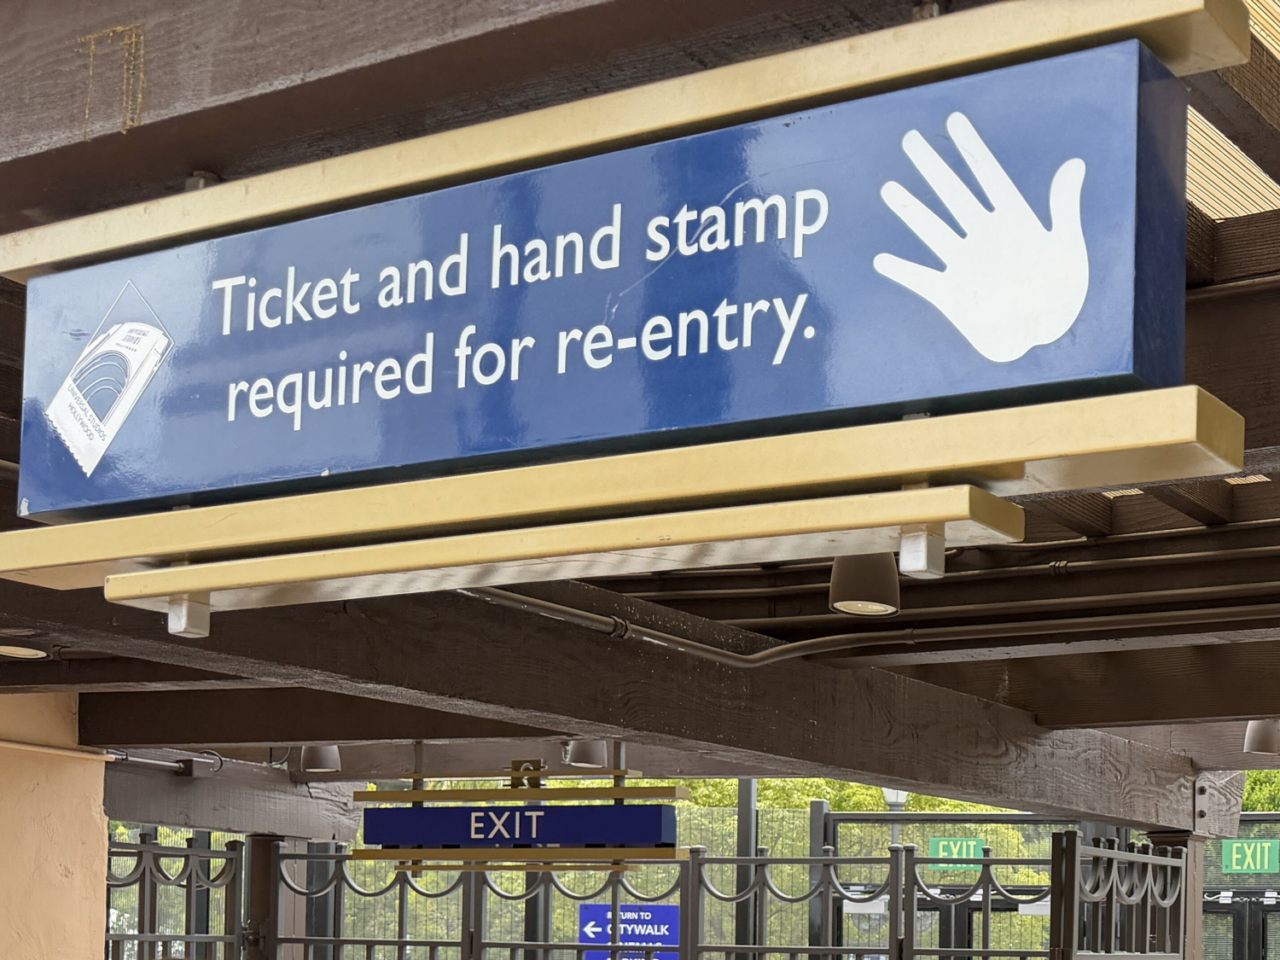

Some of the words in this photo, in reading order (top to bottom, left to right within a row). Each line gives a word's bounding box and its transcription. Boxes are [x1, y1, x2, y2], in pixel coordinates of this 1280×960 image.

[212, 267, 360, 335] Ticket
[377, 233, 468, 308] and
[491, 204, 622, 288] hand
[645, 188, 830, 261] stamp
[228, 333, 434, 431] required
[454, 325, 536, 389] for
[556, 293, 817, 374] re-entry.
[68, 402, 95, 441] HOLLYWOOD
[87, 414, 107, 441] STUDIOS
[470, 811, 545, 839] EXIT
[939, 841, 977, 868] EXIT
[1232, 842, 1271, 870] EXIT
[606, 923, 670, 936] CTYWALK
[640, 911, 651, 920] TO
